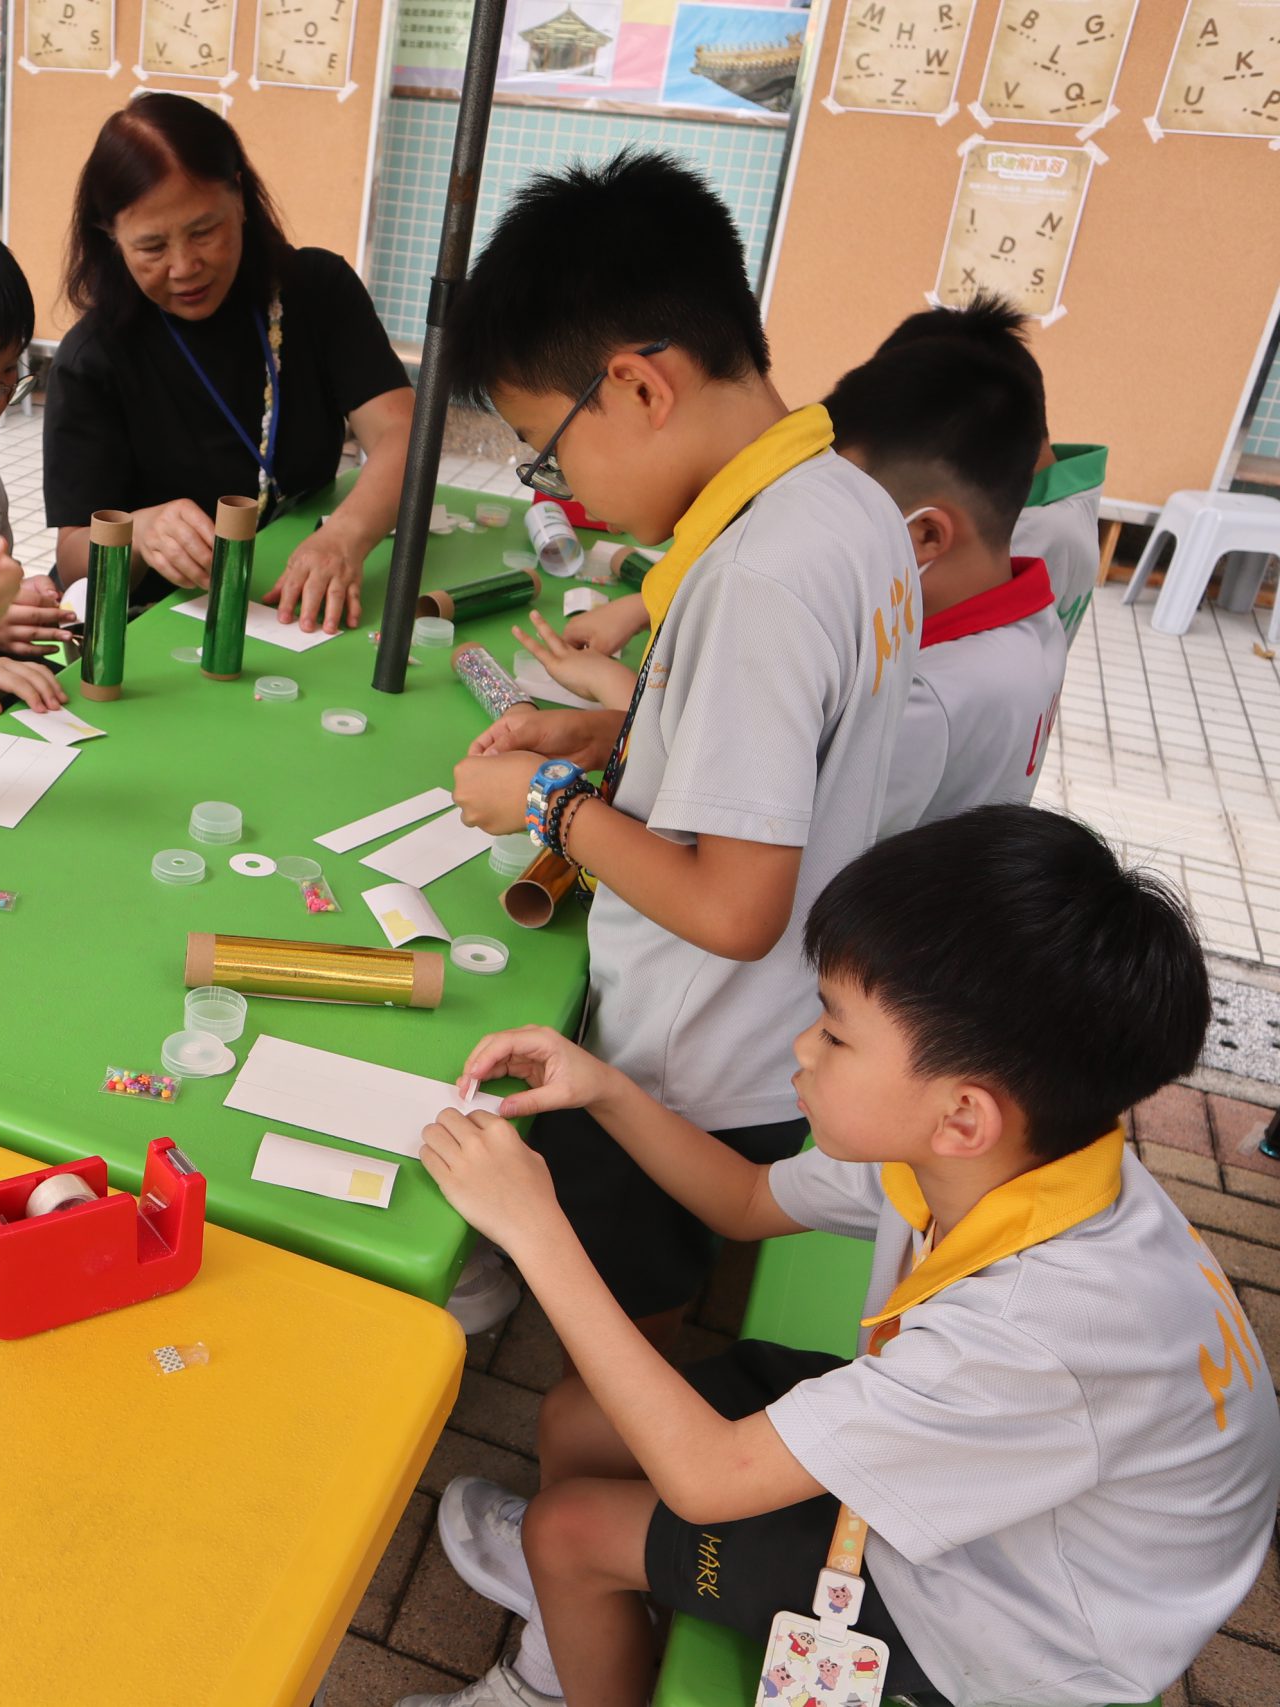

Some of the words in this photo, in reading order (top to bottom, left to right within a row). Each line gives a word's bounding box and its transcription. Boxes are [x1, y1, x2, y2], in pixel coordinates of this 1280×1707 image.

[63, 3, 75, 19] D
[184, 12, 191, 28] L
[862, 2, 885, 24] M
[939, 4, 953, 23] R
[1020, 9, 1039, 29] B
[304, 21, 318, 38] O
[896, 22, 915, 41] H
[1085, 14, 1105, 34] G
[1199, 18, 1218, 39] A
[41, 32, 53, 48] X
[90, 29, 100, 45] S
[156, 42, 167, 57] V
[199, 43, 213, 59] Q
[276, 49, 286, 64] J
[926, 48, 949, 67] W
[1049, 44, 1061, 65] L
[328, 53, 338, 69] E
[856, 53, 870, 71] C
[1235, 50, 1254, 71] K
[891, 78, 907, 97] Z
[1004, 81, 1020, 100] V
[1065, 82, 1085, 102] Q
[1184, 86, 1205, 106] U
[1262, 89, 1280, 109] P
[970, 208, 975, 226] I
[1041, 211, 1063, 233] N
[998, 236, 1016, 254] D
[961, 267, 976, 285] X
[1030, 268, 1045, 286] S
[696, 1533, 722, 1599] MARK
